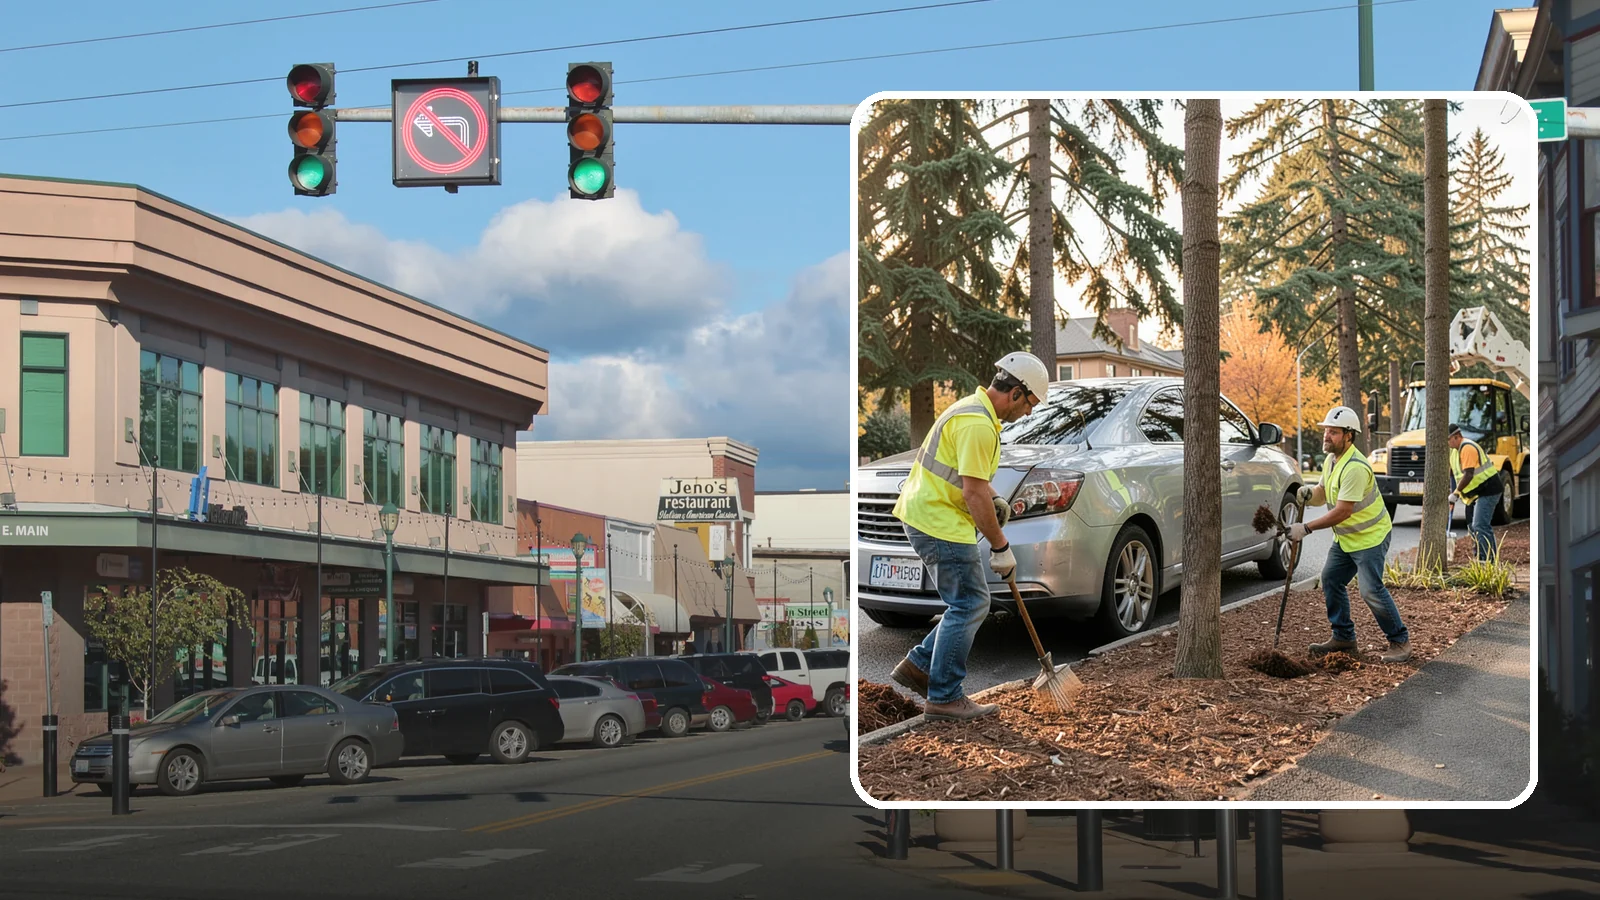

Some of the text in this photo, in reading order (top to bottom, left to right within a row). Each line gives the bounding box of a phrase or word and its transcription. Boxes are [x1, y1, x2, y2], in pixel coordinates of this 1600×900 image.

[669, 480, 728, 495] Jeno's
[665, 496, 731, 509] restaurant
[686, 509, 715, 520] American
[2, 525, 49, 536] E. MAIN
[797, 607, 829, 617] Street
